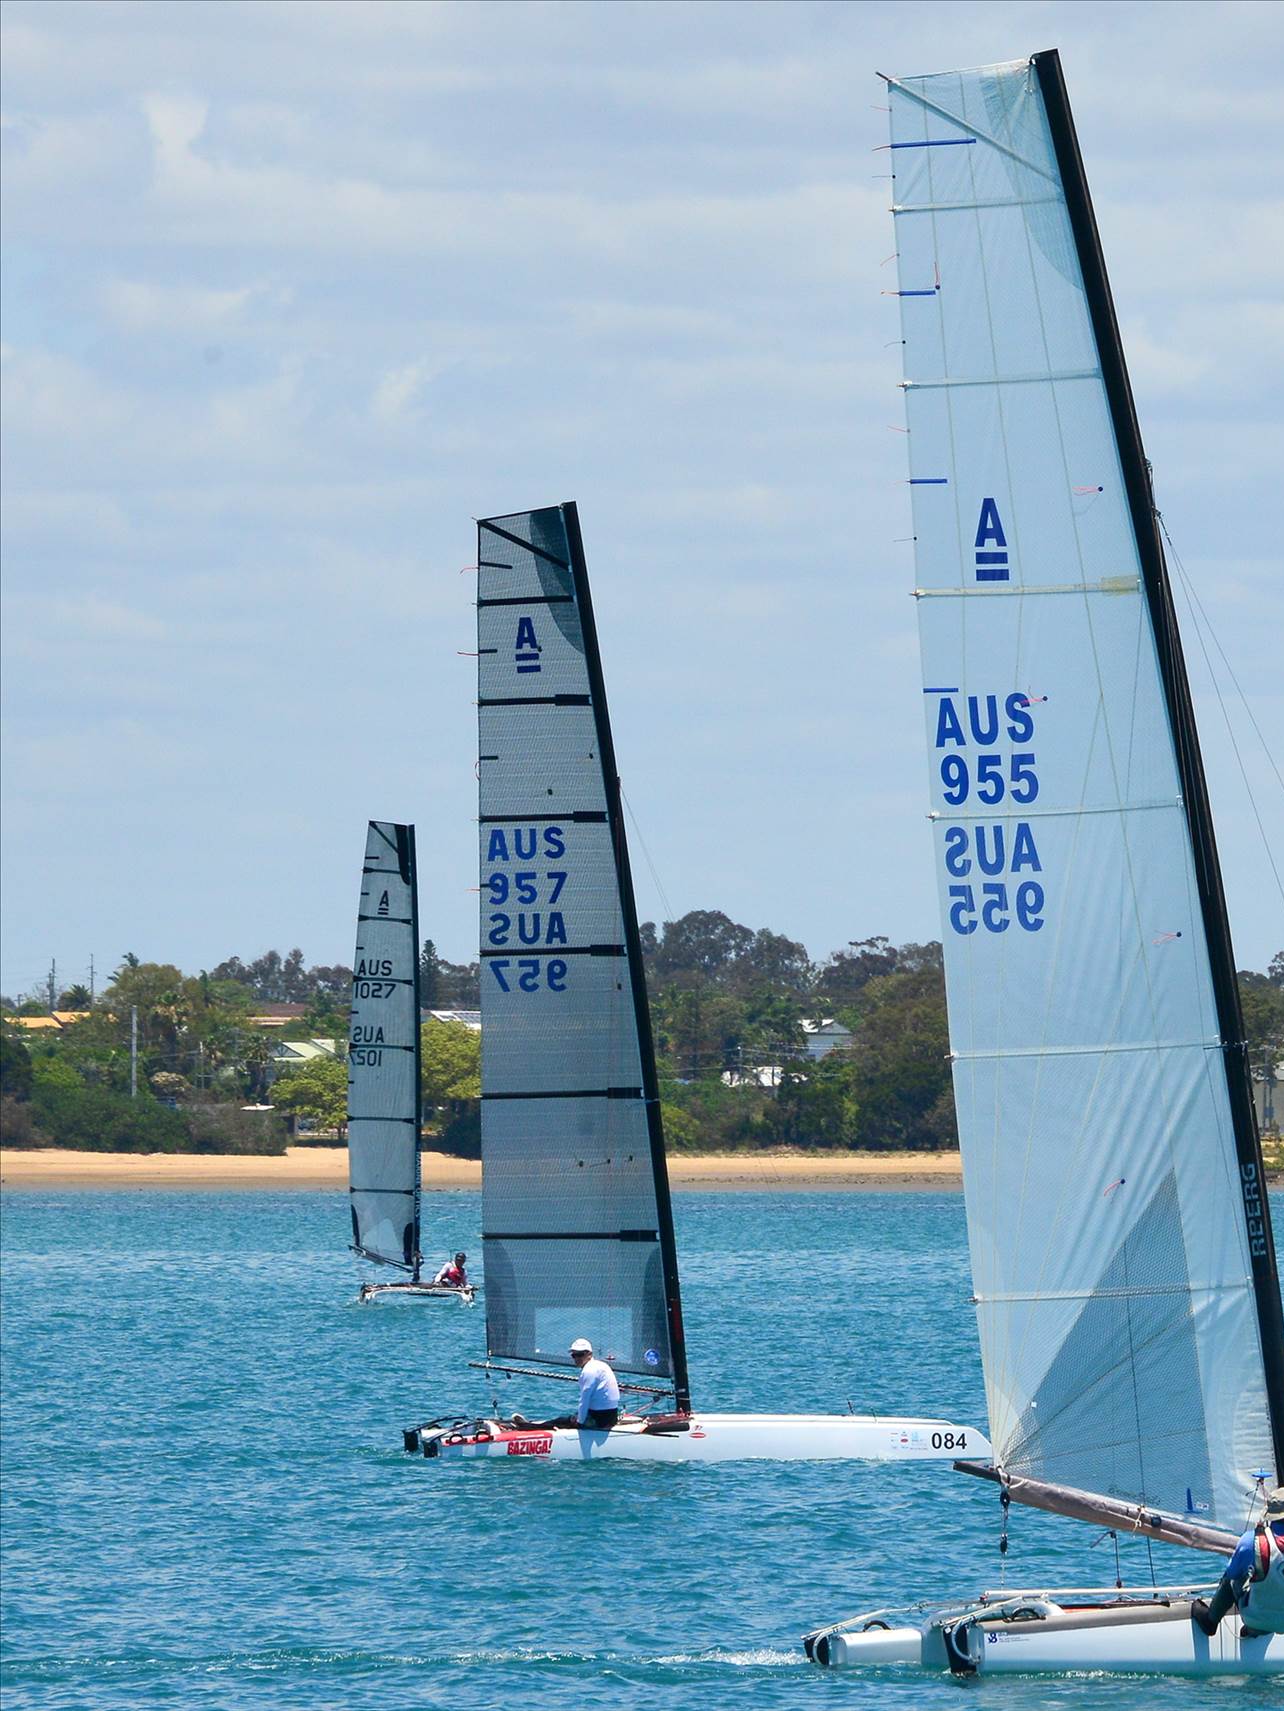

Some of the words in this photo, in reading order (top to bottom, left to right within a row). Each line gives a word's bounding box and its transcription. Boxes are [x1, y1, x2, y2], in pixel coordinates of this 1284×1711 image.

[975, 497, 1008, 548] A
[515, 616, 538, 650] A
[935, 690, 1034, 748] AUS
[940, 753, 1039, 806] 955
[487, 826, 566, 862] AUS
[379, 890, 390, 907] A
[488, 871, 567, 905] 957
[358, 959, 393, 977] AUS
[355, 982, 397, 999] 1027
[507, 1439, 553, 1456] BAZINGA!
[930, 1432, 968, 1450] 084
